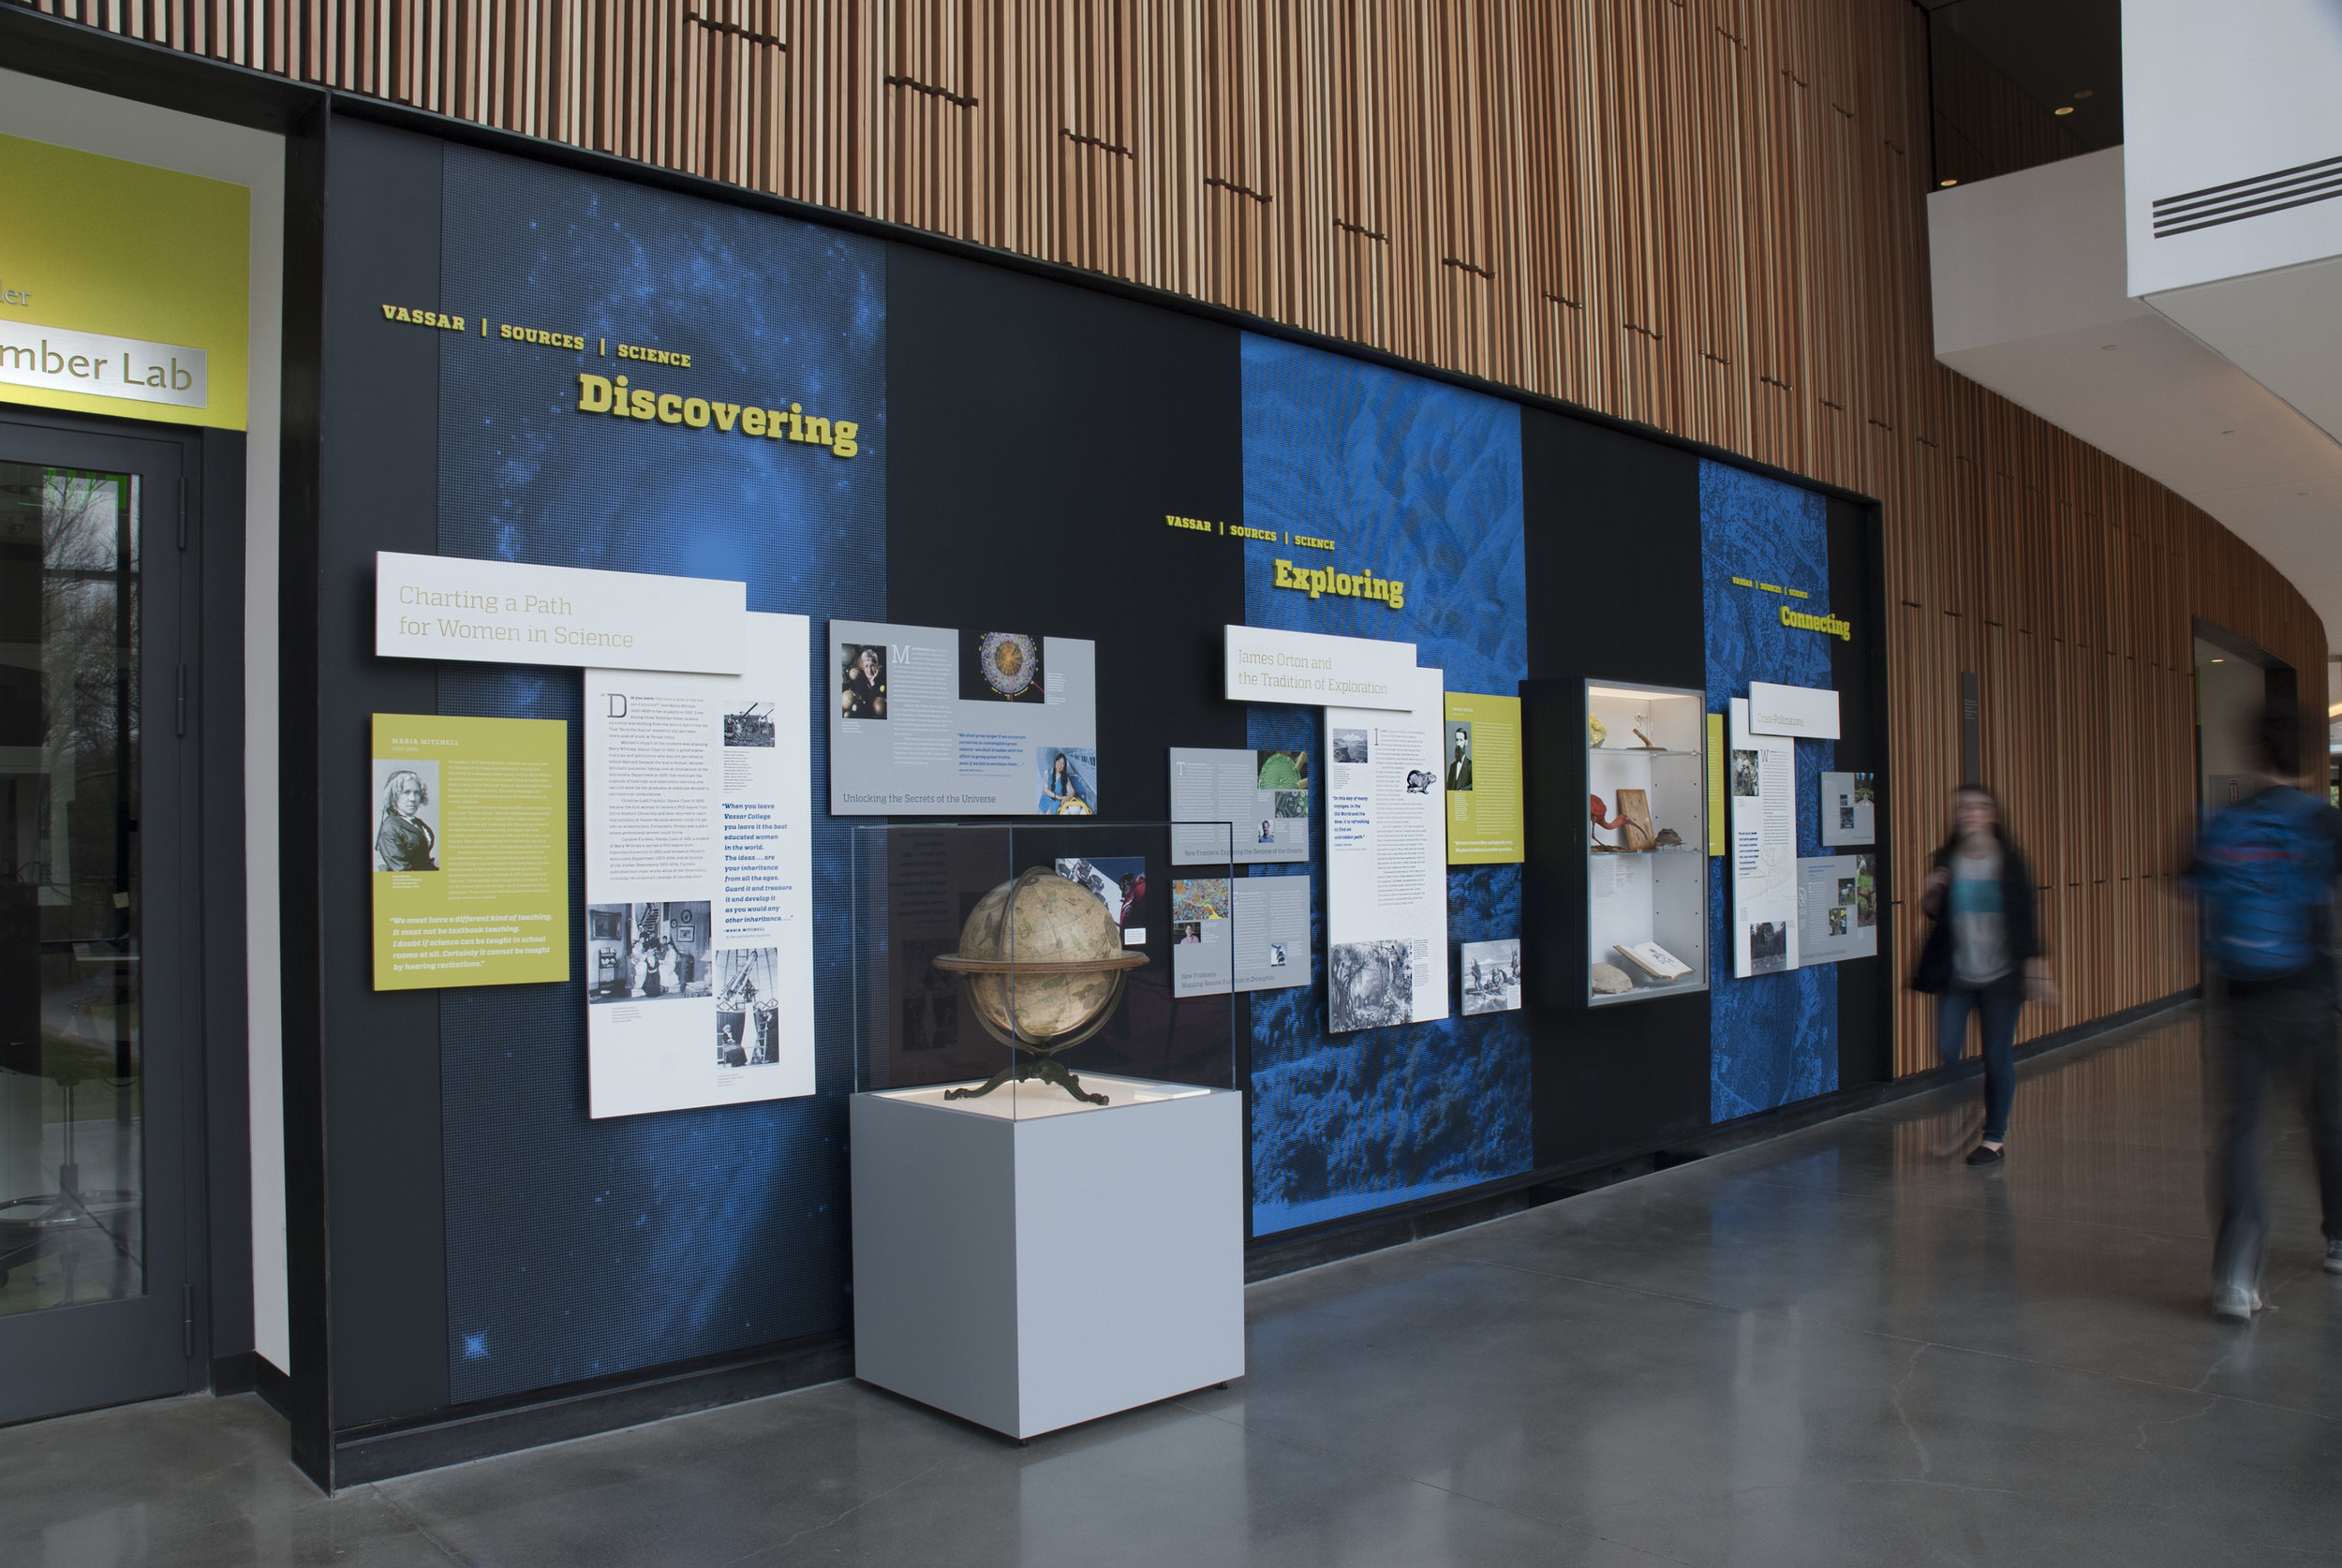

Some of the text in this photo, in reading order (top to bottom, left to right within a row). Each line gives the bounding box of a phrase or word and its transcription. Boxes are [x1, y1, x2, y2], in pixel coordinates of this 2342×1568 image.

[382, 304, 691, 368] VASSAR SOURCES SCIENCE
[0, 340, 192, 391] mber Lab
[578, 373, 858, 457] Discovering
[1166, 515, 1335, 550] VASSAR SOURCES SCIENCE
[1273, 559, 1403, 609] Exploring
[399, 586, 573, 615] Charting a Path
[399, 616, 633, 648] for Women in Science
[1781, 606, 1850, 641] Connecting
[1238, 649, 1332, 670] James Orton and
[1238, 672, 1387, 694] the Tradition of Exploration
[843, 794, 996, 804] Unlocking the Secrets of the Universe
[485, 925, 520, 934] teaching.
[518, 913, 552, 922] teaching.
[443, 949, 478, 957] Certainly
[526, 946, 550, 955] taught
[486, 937, 511, 945] taught
[393, 960, 485, 971] by hearing recitations.”
